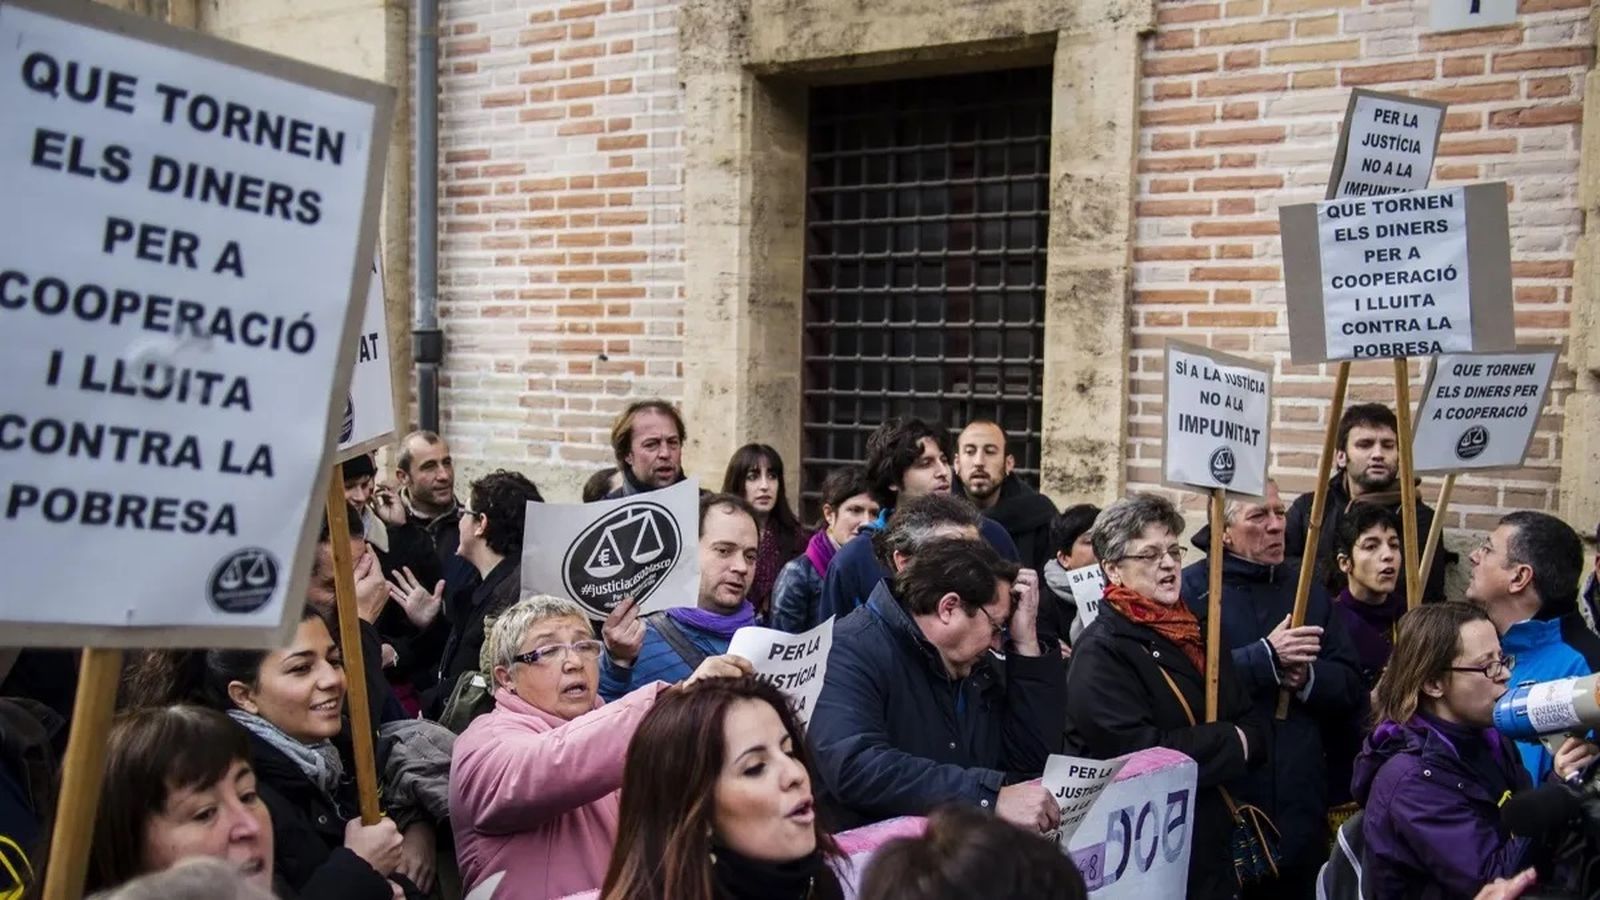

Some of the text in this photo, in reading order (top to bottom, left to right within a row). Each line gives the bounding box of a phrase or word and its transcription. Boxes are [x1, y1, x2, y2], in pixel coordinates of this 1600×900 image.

[21, 52, 345, 165] QUE TORNEN
[1374, 108, 1418, 128] PER LA
[1362, 132, 1421, 154] JUSTÍCIA
[31, 128, 322, 225] ELS DINERS
[1361, 158, 1413, 178] NO A LA
[1344, 181, 1414, 197] IMPUNIT
[1327, 194, 1453, 219] QUE TORNEN
[1335, 219, 1448, 242] ELS DINERS
[103, 216, 246, 278] PER A
[1364, 246, 1421, 263] PER A
[1331, 264, 1457, 289] COOPERACIÓ
[0, 270, 316, 354] COOPERACIÓ
[1355, 293, 1436, 312] I LLUITA
[1342, 316, 1452, 335] CONTRA LA
[1353, 340, 1443, 357] POBRESA
[46, 349, 253, 412] I LLUITA
[1175, 359, 1265, 395] SÍ A LA JUSTÍCIA
[1452, 363, 1536, 377] QUE TORNEN
[1200, 390, 1244, 412] NO A LA
[1436, 384, 1539, 399] ELS DINERS PER
[1433, 403, 1528, 420] A COOPERACIÓ
[1179, 413, 1261, 446] IMPUNITAT
[0, 414, 275, 478] CONTRA LA
[5, 484, 238, 536] POBRESA
[768, 636, 820, 661] PER LA
[1069, 765, 1112, 779] PER LA
